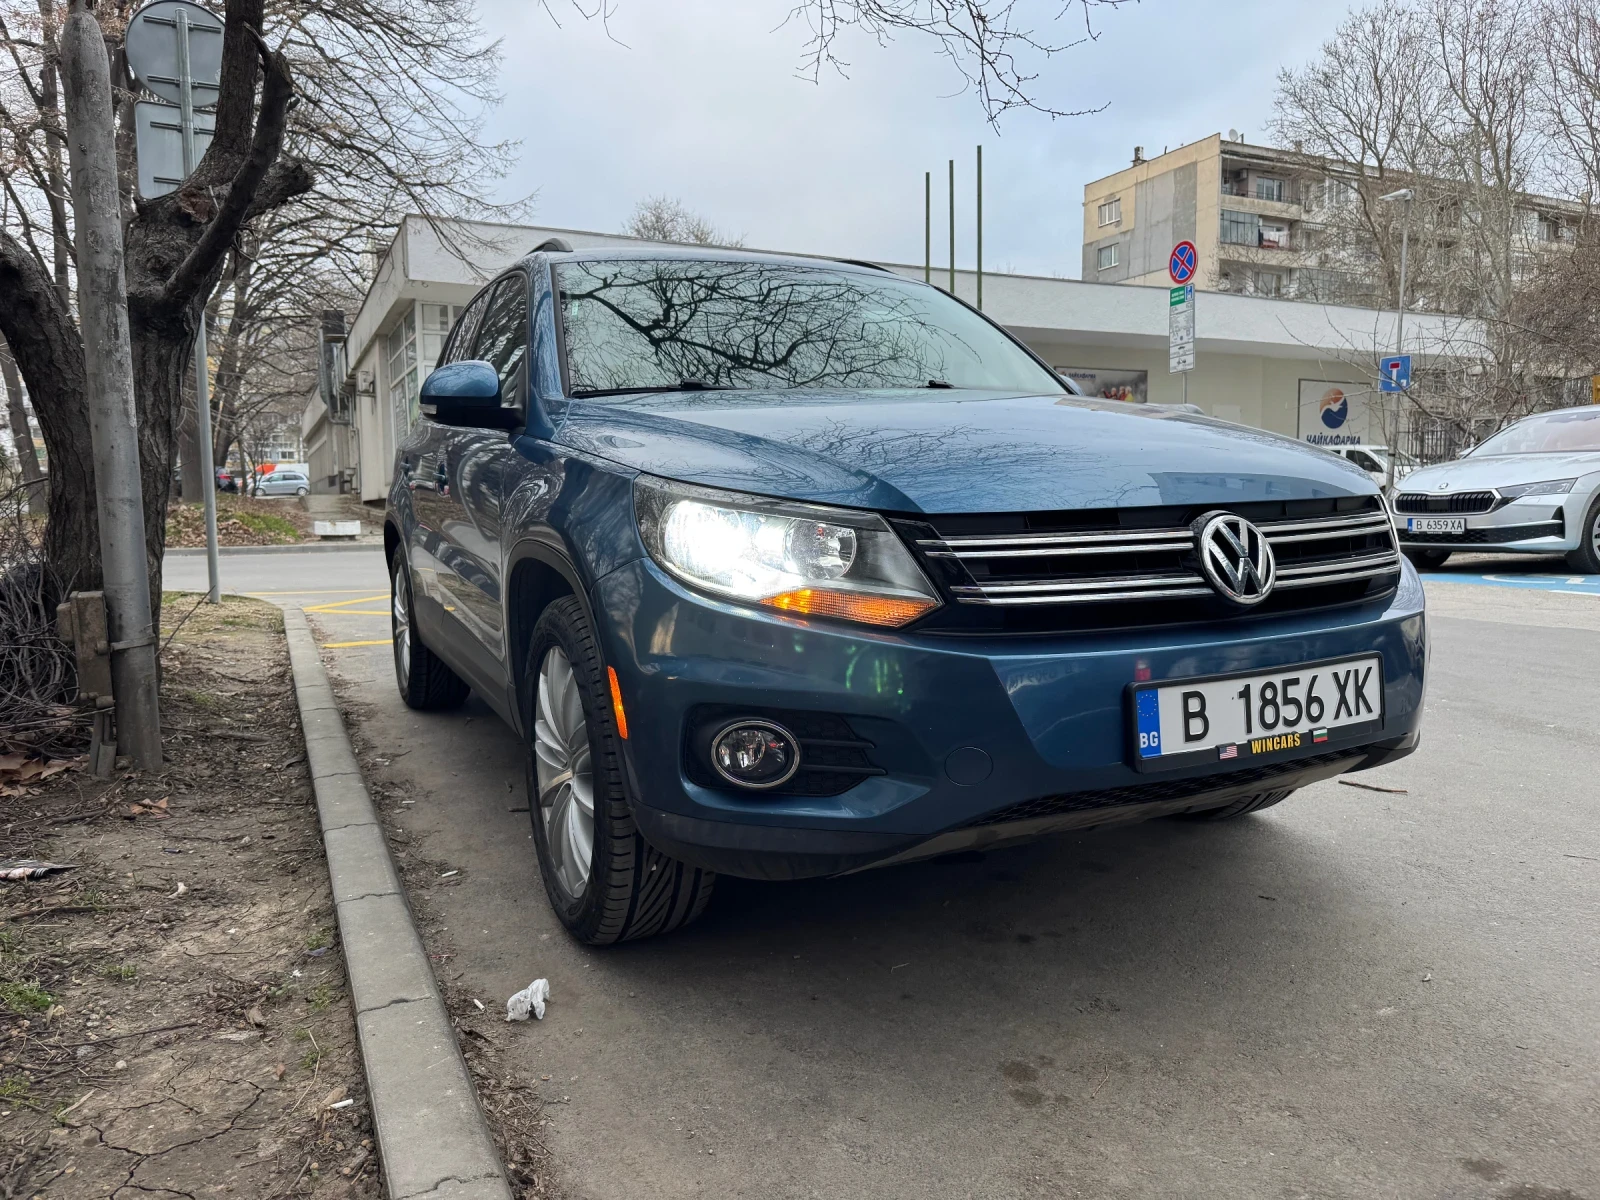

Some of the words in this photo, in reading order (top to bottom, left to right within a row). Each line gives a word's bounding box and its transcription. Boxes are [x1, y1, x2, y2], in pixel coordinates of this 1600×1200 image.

[1306, 432, 1360, 445] ЧАЙКАФАРМА
[1426, 520, 1449, 530] 6359
[1182, 690, 1210, 743] B
[1237, 675, 1325, 735] 1856
[1331, 666, 1374, 720] XK
[1139, 731, 1159, 748] BG
[1251, 733, 1301, 754] WINCARS
